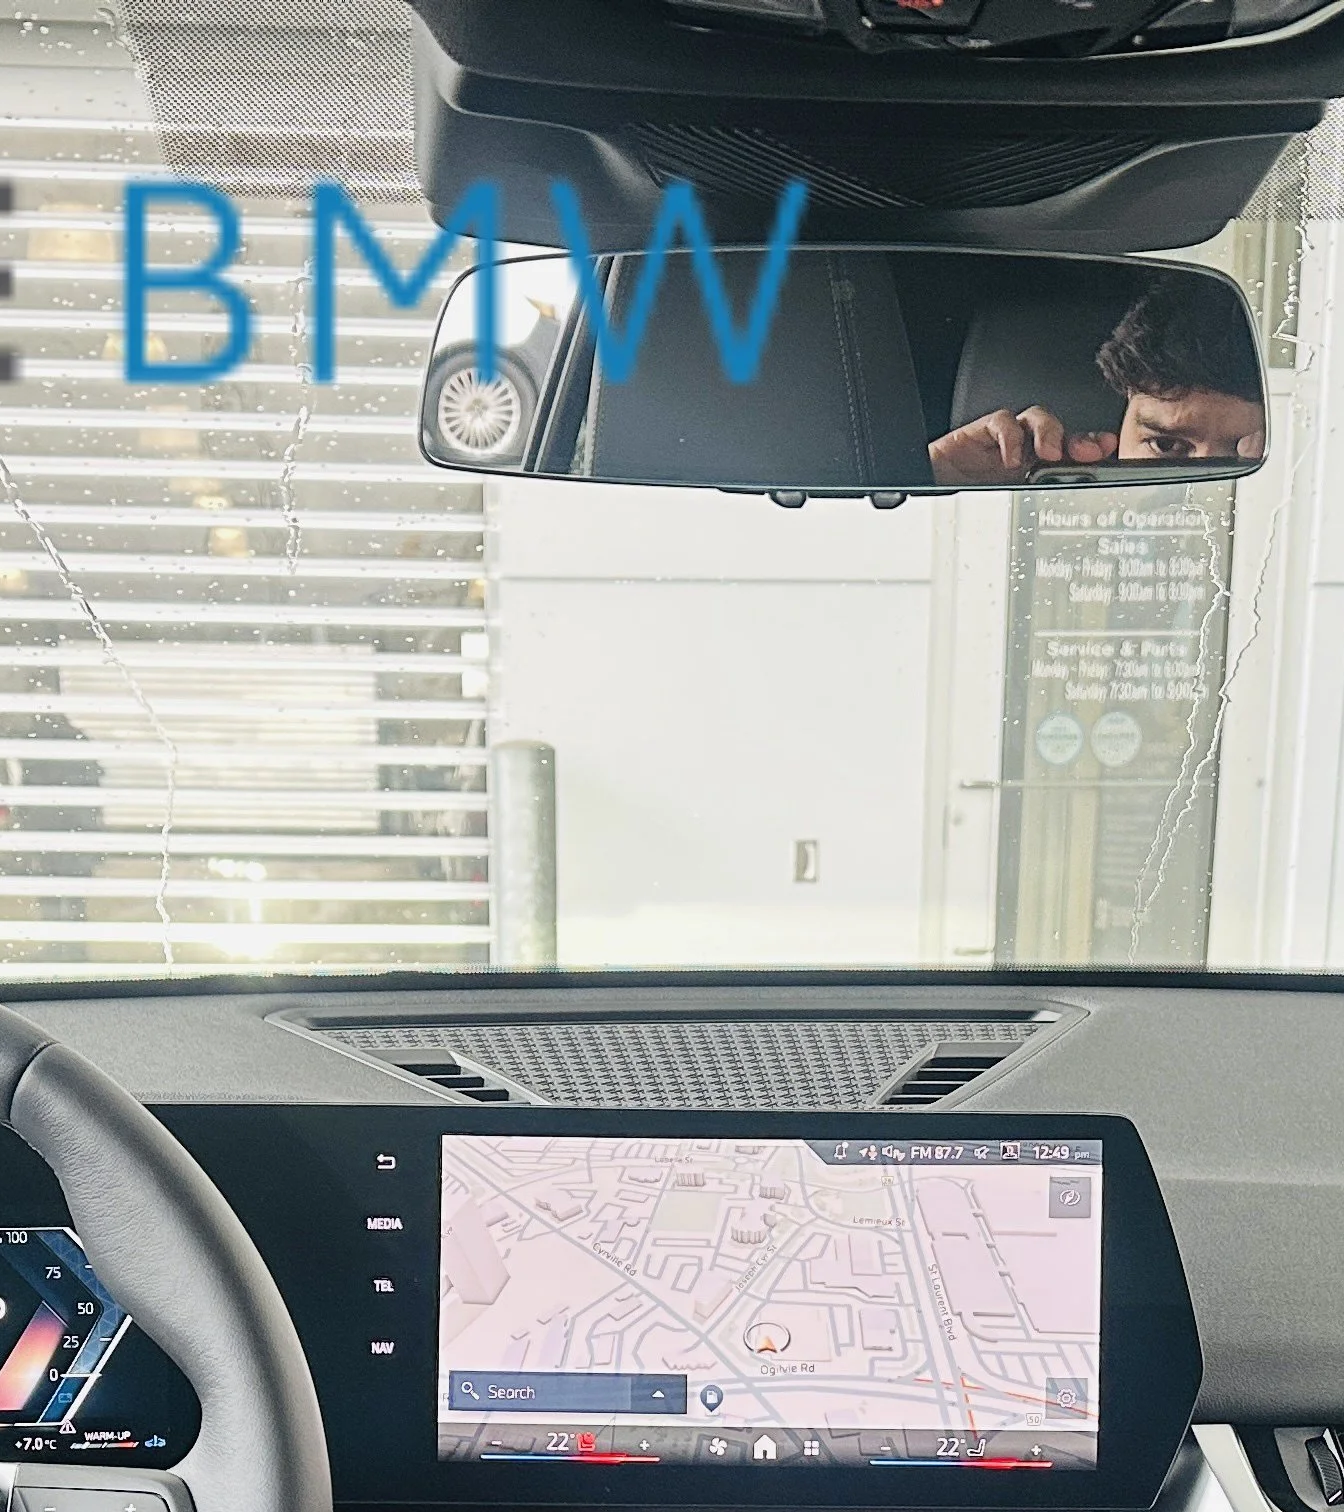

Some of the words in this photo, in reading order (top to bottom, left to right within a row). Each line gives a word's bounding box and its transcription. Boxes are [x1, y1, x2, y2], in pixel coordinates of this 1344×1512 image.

[1038, 508, 1091, 527] Hours
[1096, 510, 1118, 527] of
[1097, 537, 1149, 555] Sales
[1047, 640, 1114, 657] Service
[910, 1147, 931, 1159] FM
[934, 1146, 964, 1160] 87.7
[1032, 1145, 1070, 1160] 12:49
[1074, 1151, 1090, 1161] pm
[366, 1217, 404, 1230] MEDIA
[853, 1216, 893, 1226] Lemieux
[895, 1217, 905, 1226] St
[6, 1231, 28, 1244] 100
[45, 1266, 61, 1279] 75
[623, 1262, 637, 1276] Rd
[927, 1264, 938, 1278] St
[373, 1279, 395, 1292] TEL
[931, 1279, 949, 1318] Laurent
[77, 1302, 94, 1315] 50
[942, 1318, 957, 1341] Blvd
[63, 1336, 80, 1349] 25
[371, 1342, 395, 1355] NAV
[49, 1369, 59, 1382] 0
[760, 1363, 798, 1375] Ogilvie
[800, 1363, 815, 1374] Rd
[487, 1384, 536, 1400] Search
[84, 1430, 131, 1441] WARM-UP
